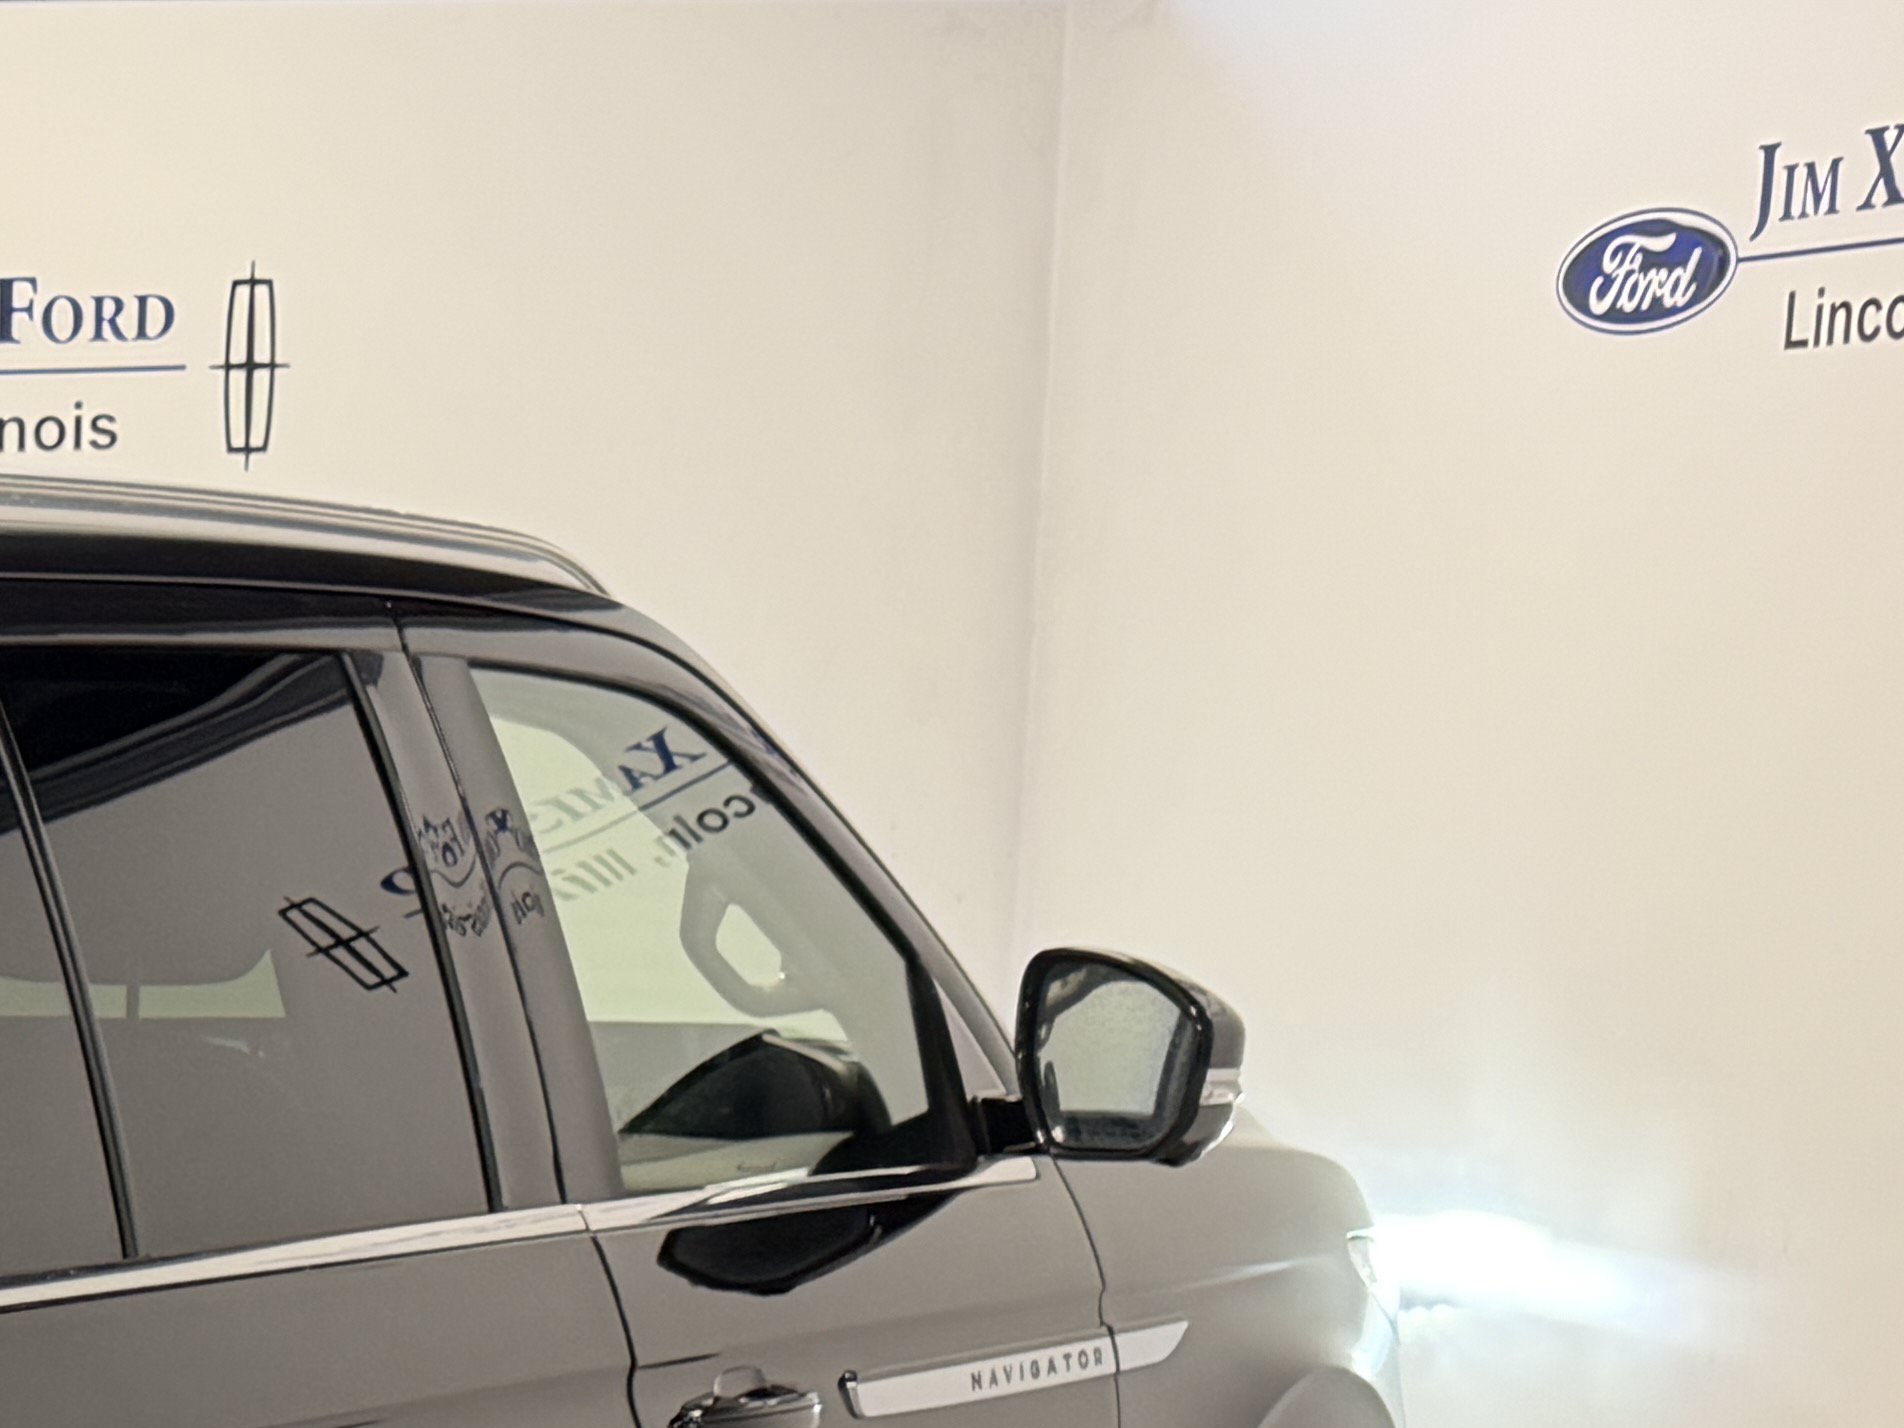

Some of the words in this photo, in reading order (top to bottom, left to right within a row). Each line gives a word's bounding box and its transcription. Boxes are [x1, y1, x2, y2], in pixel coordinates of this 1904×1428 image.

[1750, 141, 1844, 242] JIM
[1588, 231, 1703, 317] Ford
[970, 1346, 1104, 1393] NAVIGATOR
